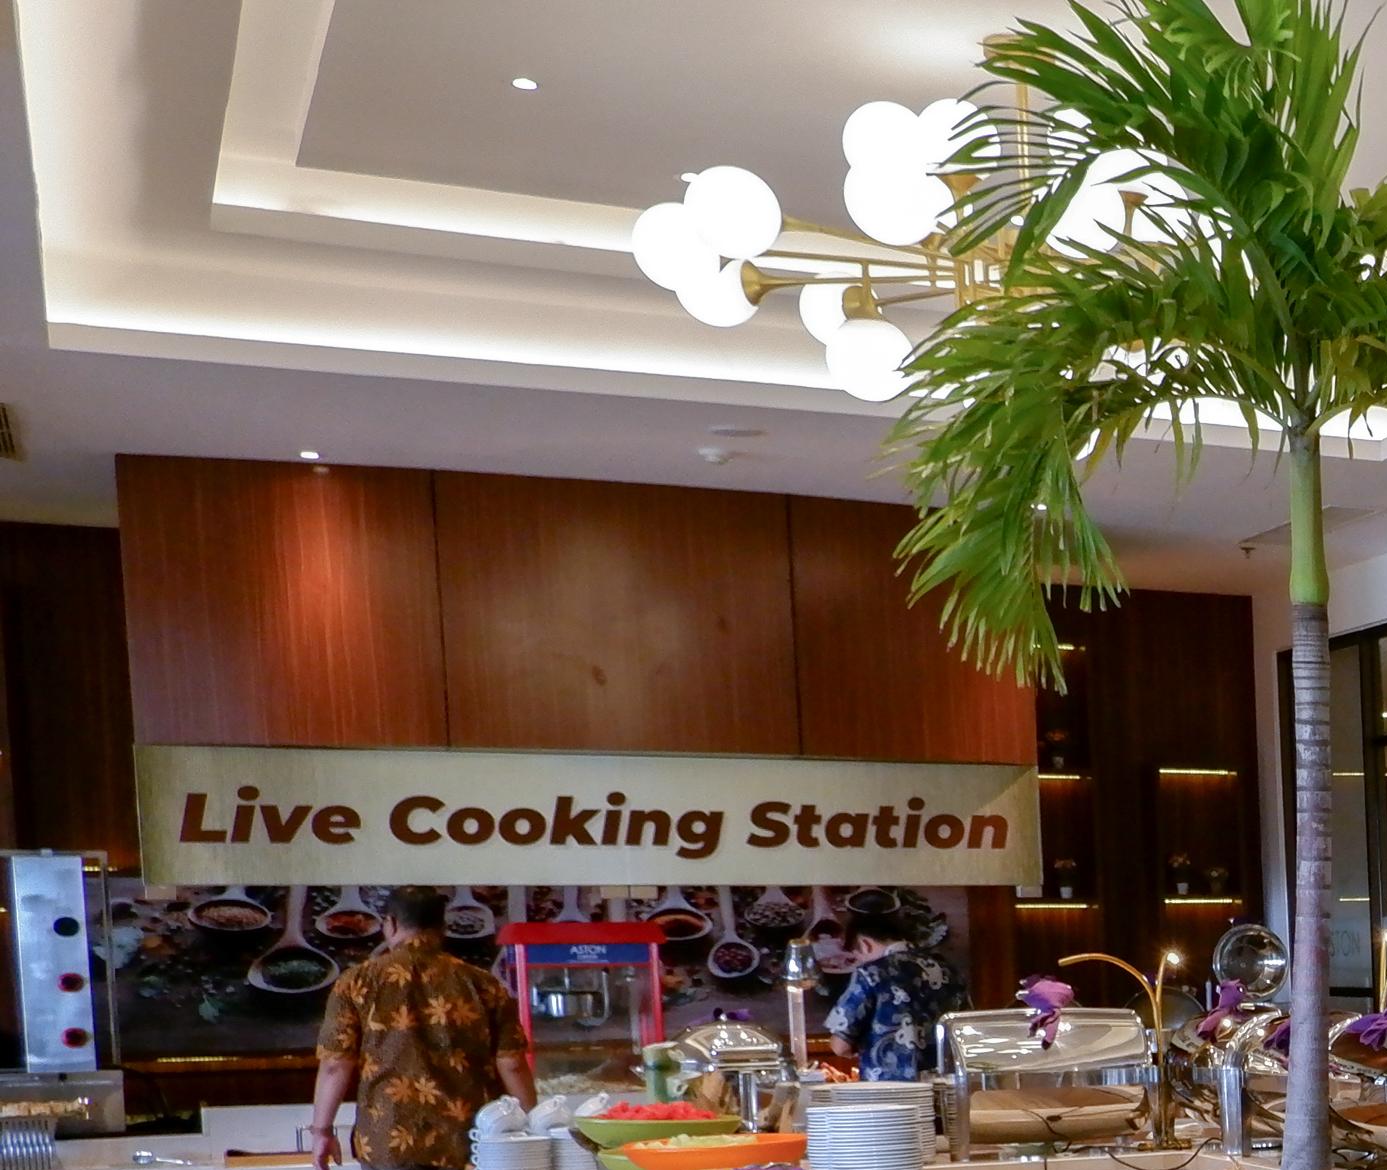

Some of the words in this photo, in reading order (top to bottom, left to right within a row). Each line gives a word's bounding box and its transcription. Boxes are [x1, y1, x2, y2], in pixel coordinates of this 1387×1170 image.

[179, 785, 362, 845] Live
[389, 791, 724, 860] Cooking
[746, 796, 1009, 850] Station
[1329, 929, 1361, 957] STON
